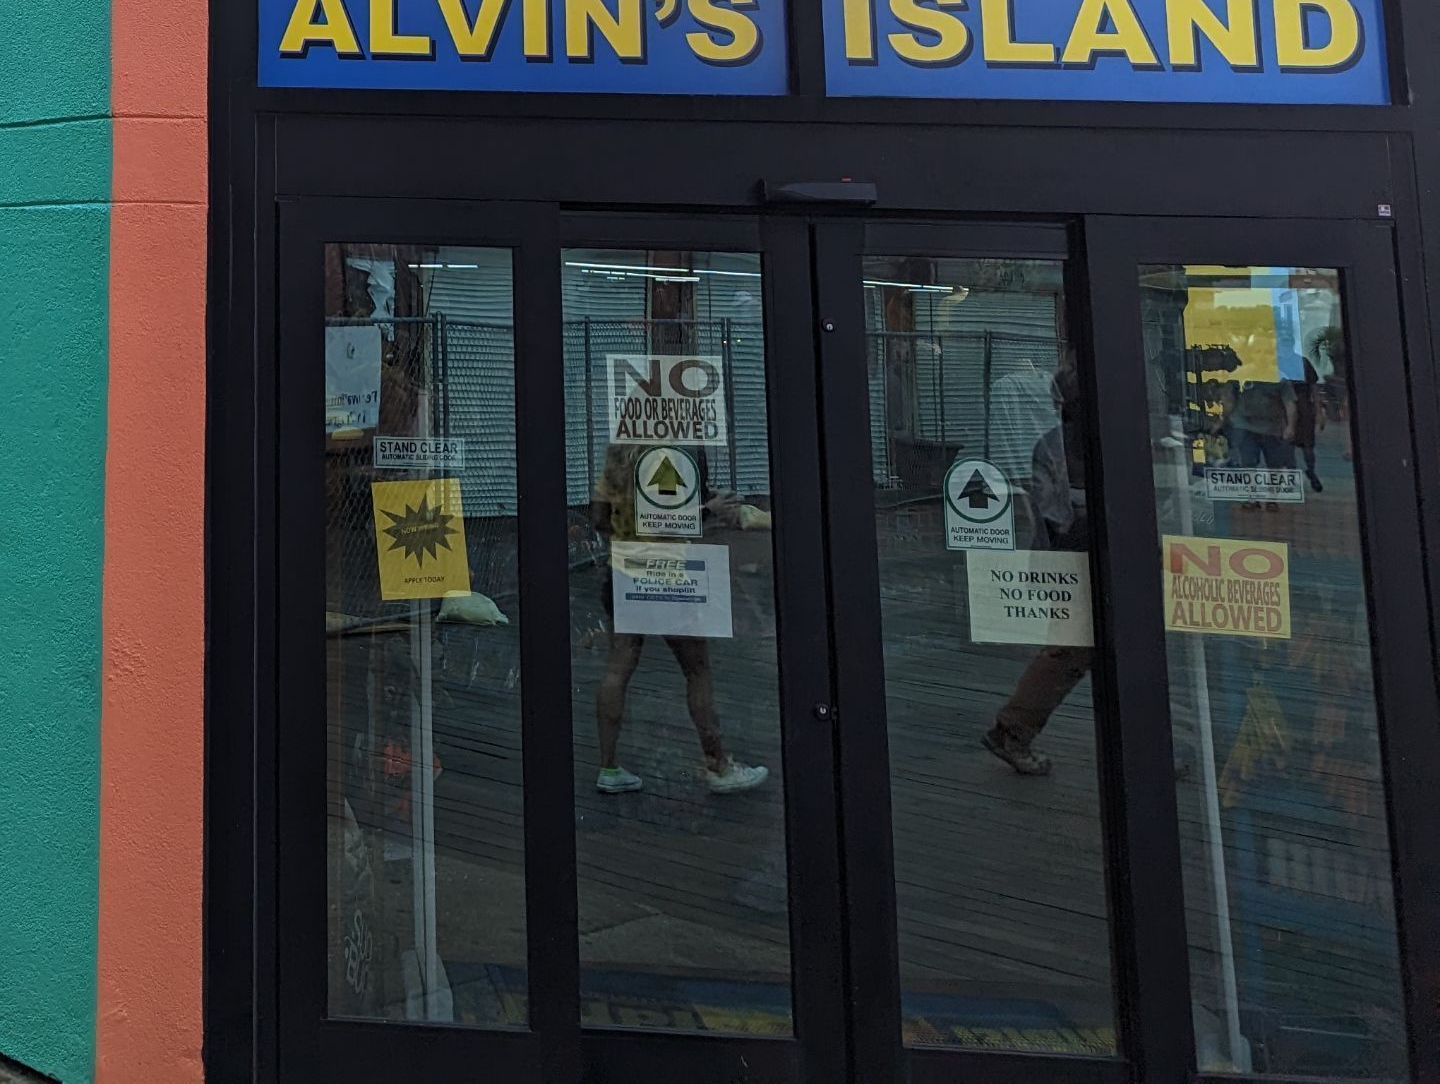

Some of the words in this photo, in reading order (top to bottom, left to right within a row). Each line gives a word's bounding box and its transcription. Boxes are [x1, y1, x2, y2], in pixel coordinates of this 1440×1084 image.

[613, 358, 720, 398] NO
[613, 397, 642, 420] FOOD
[644, 397, 659, 421] OR
[661, 397, 717, 422] BEVERAGES
[616, 420, 719, 439] ALLOWED
[380, 441, 417, 453] STAND
[420, 441, 458, 454] CLEAR
[1211, 472, 1251, 485] STAND
[1254, 474, 1295, 486] CLEAR
[640, 513, 677, 521] AUTOMATIC
[642, 521, 663, 529] KEEP
[664, 522, 696, 530] MOVING
[950, 526, 989, 535] AUTOMATIC
[990, 528, 1010, 536] DOOR
[953, 535, 975, 543] KEEP
[976, 536, 1009, 544] MOVING
[646, 559, 687, 570] FREE
[1169, 542, 1286, 580] NO
[632, 577, 673, 586] POLICE
[675, 579, 698, 587] CAR
[990, 569, 1014, 583] NO
[1018, 571, 1079, 585] DRINKS
[644, 586, 661, 594] you
[1000, 588, 1023, 601] NO
[1027, 589, 1072, 602] FOOD
[1171, 575, 1226, 603] ALCOHOLIC
[1226, 579, 1281, 607] BEVERAGES
[1003, 606, 1070, 619] THANKS
[1171, 601, 1283, 633] ALLOWED
